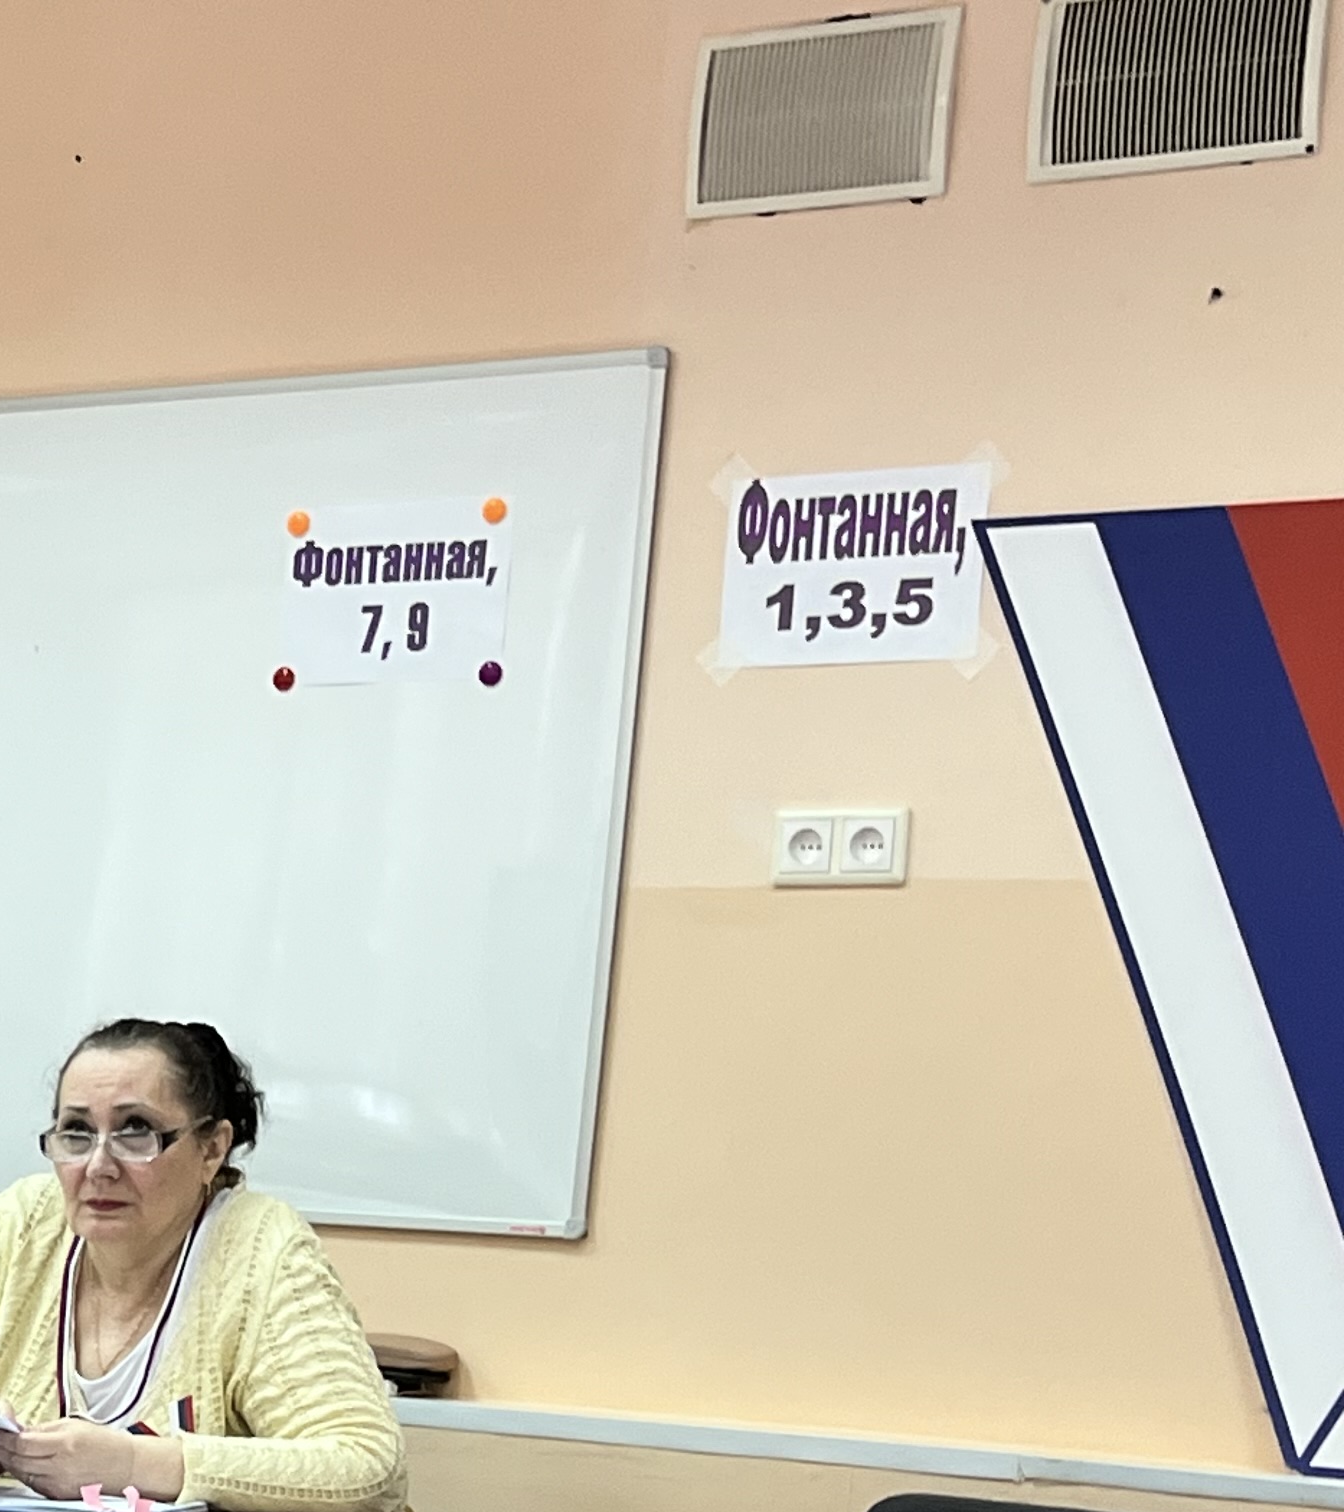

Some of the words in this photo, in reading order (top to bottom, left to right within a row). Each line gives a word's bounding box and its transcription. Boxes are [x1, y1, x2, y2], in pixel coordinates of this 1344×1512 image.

[738, 478, 967, 576] Фонтанная,
[292, 538, 499, 587] Фонтанная,
[765, 577, 934, 642] 1,3,5
